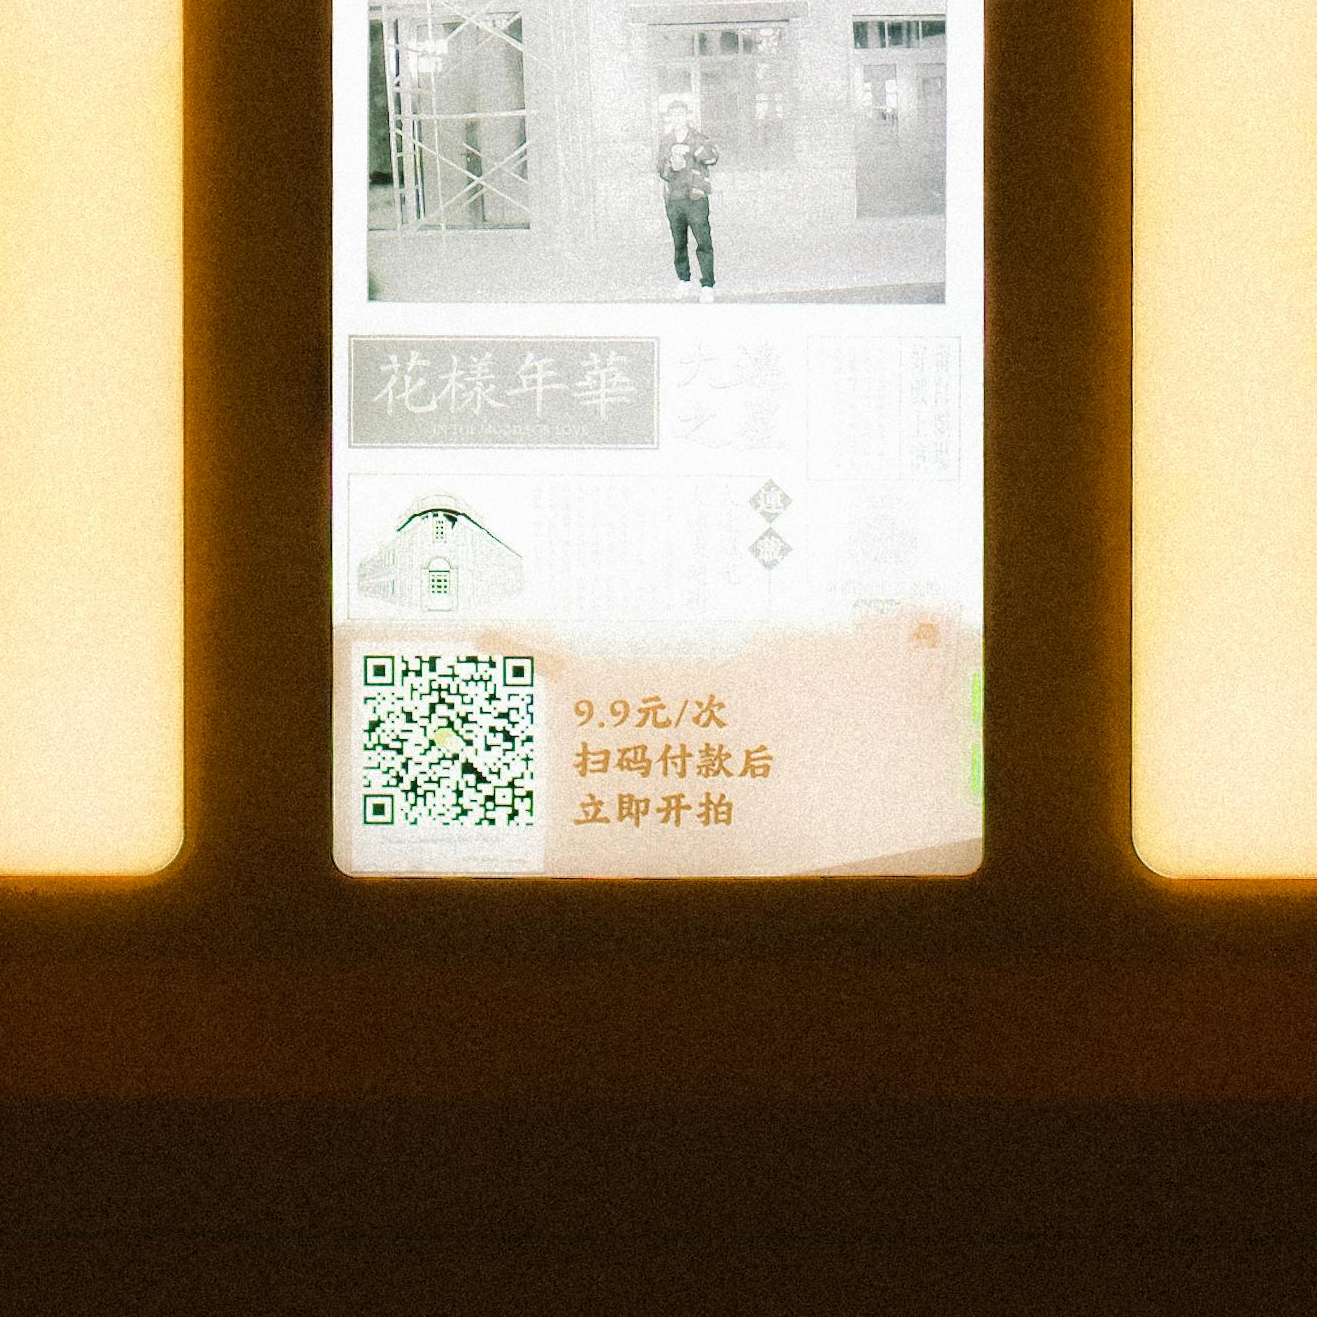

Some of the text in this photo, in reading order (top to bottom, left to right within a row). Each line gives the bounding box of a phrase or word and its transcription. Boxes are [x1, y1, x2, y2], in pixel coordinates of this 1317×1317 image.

[373, 349, 638, 421] 花樣年華
[574, 694, 728, 729] 9.9元/次
[574, 741, 774, 780] 扫码付款后
[574, 791, 733, 828] 立即开拍
